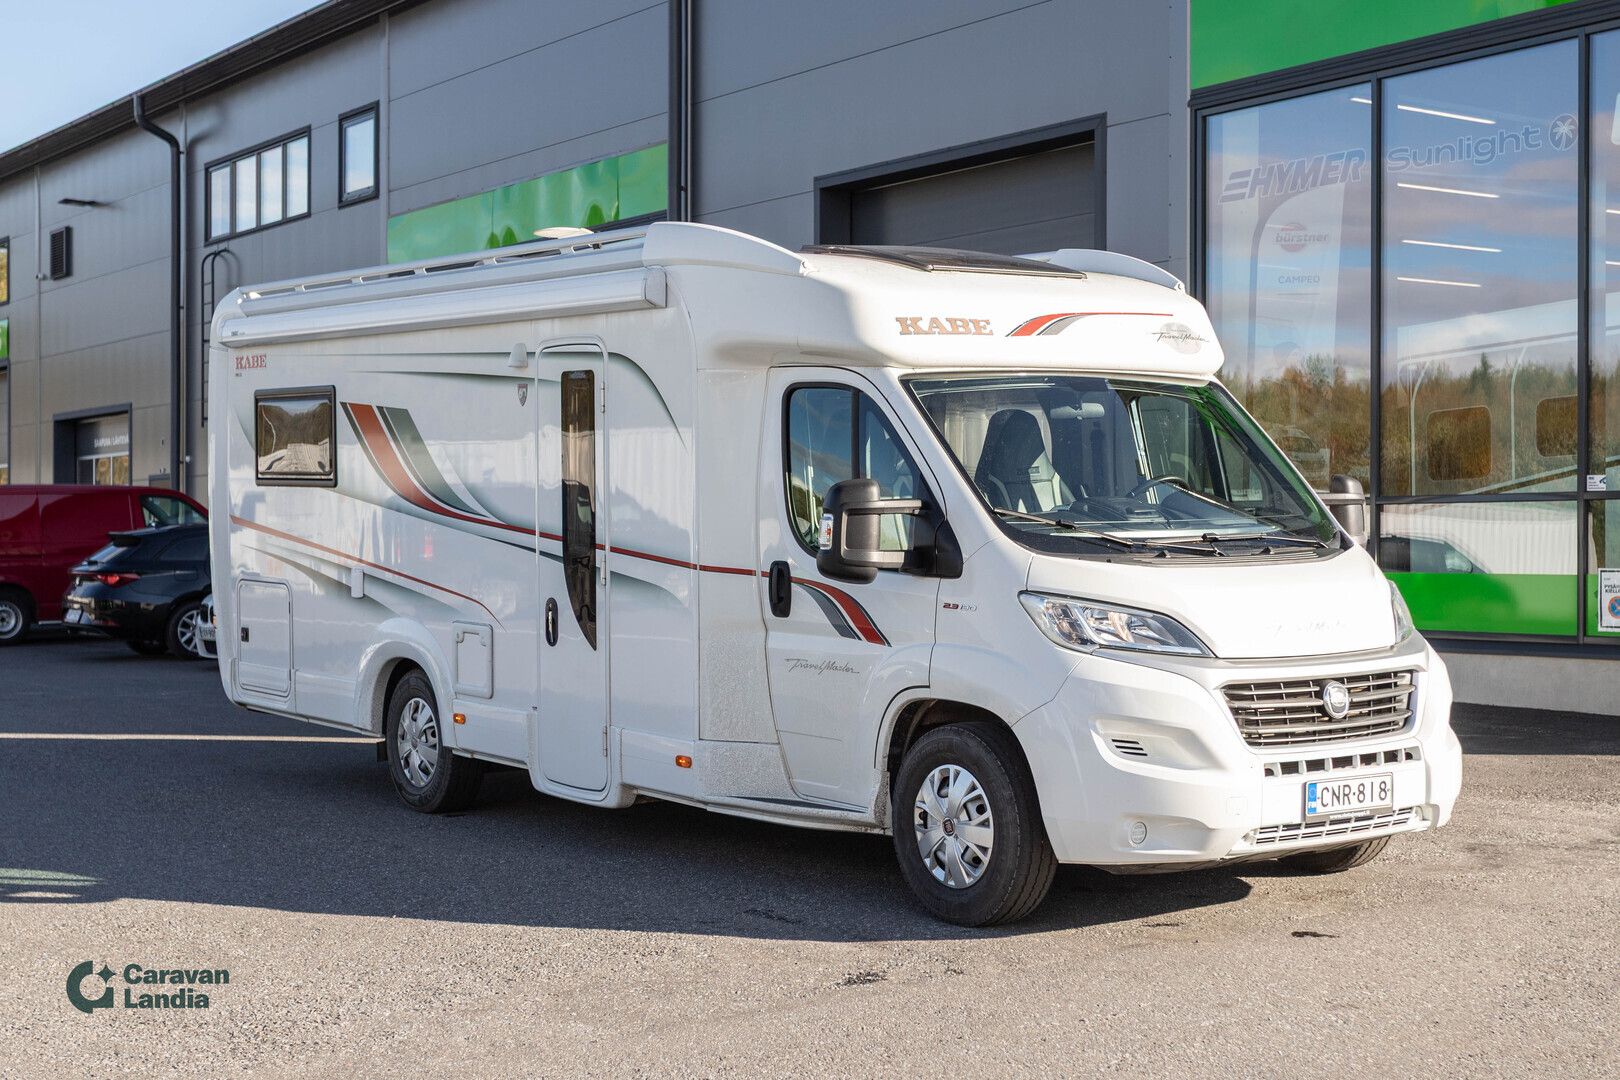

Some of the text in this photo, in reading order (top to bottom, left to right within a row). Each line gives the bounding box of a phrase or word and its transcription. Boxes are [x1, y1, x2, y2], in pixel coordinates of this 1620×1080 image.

[1386, 124, 1543, 173] Sunlight
[1246, 147, 1367, 200] HYMER
[1275, 230, 1329, 243] bürstner
[895, 316, 994, 336] KABE
[235, 353, 267, 369] KABE
